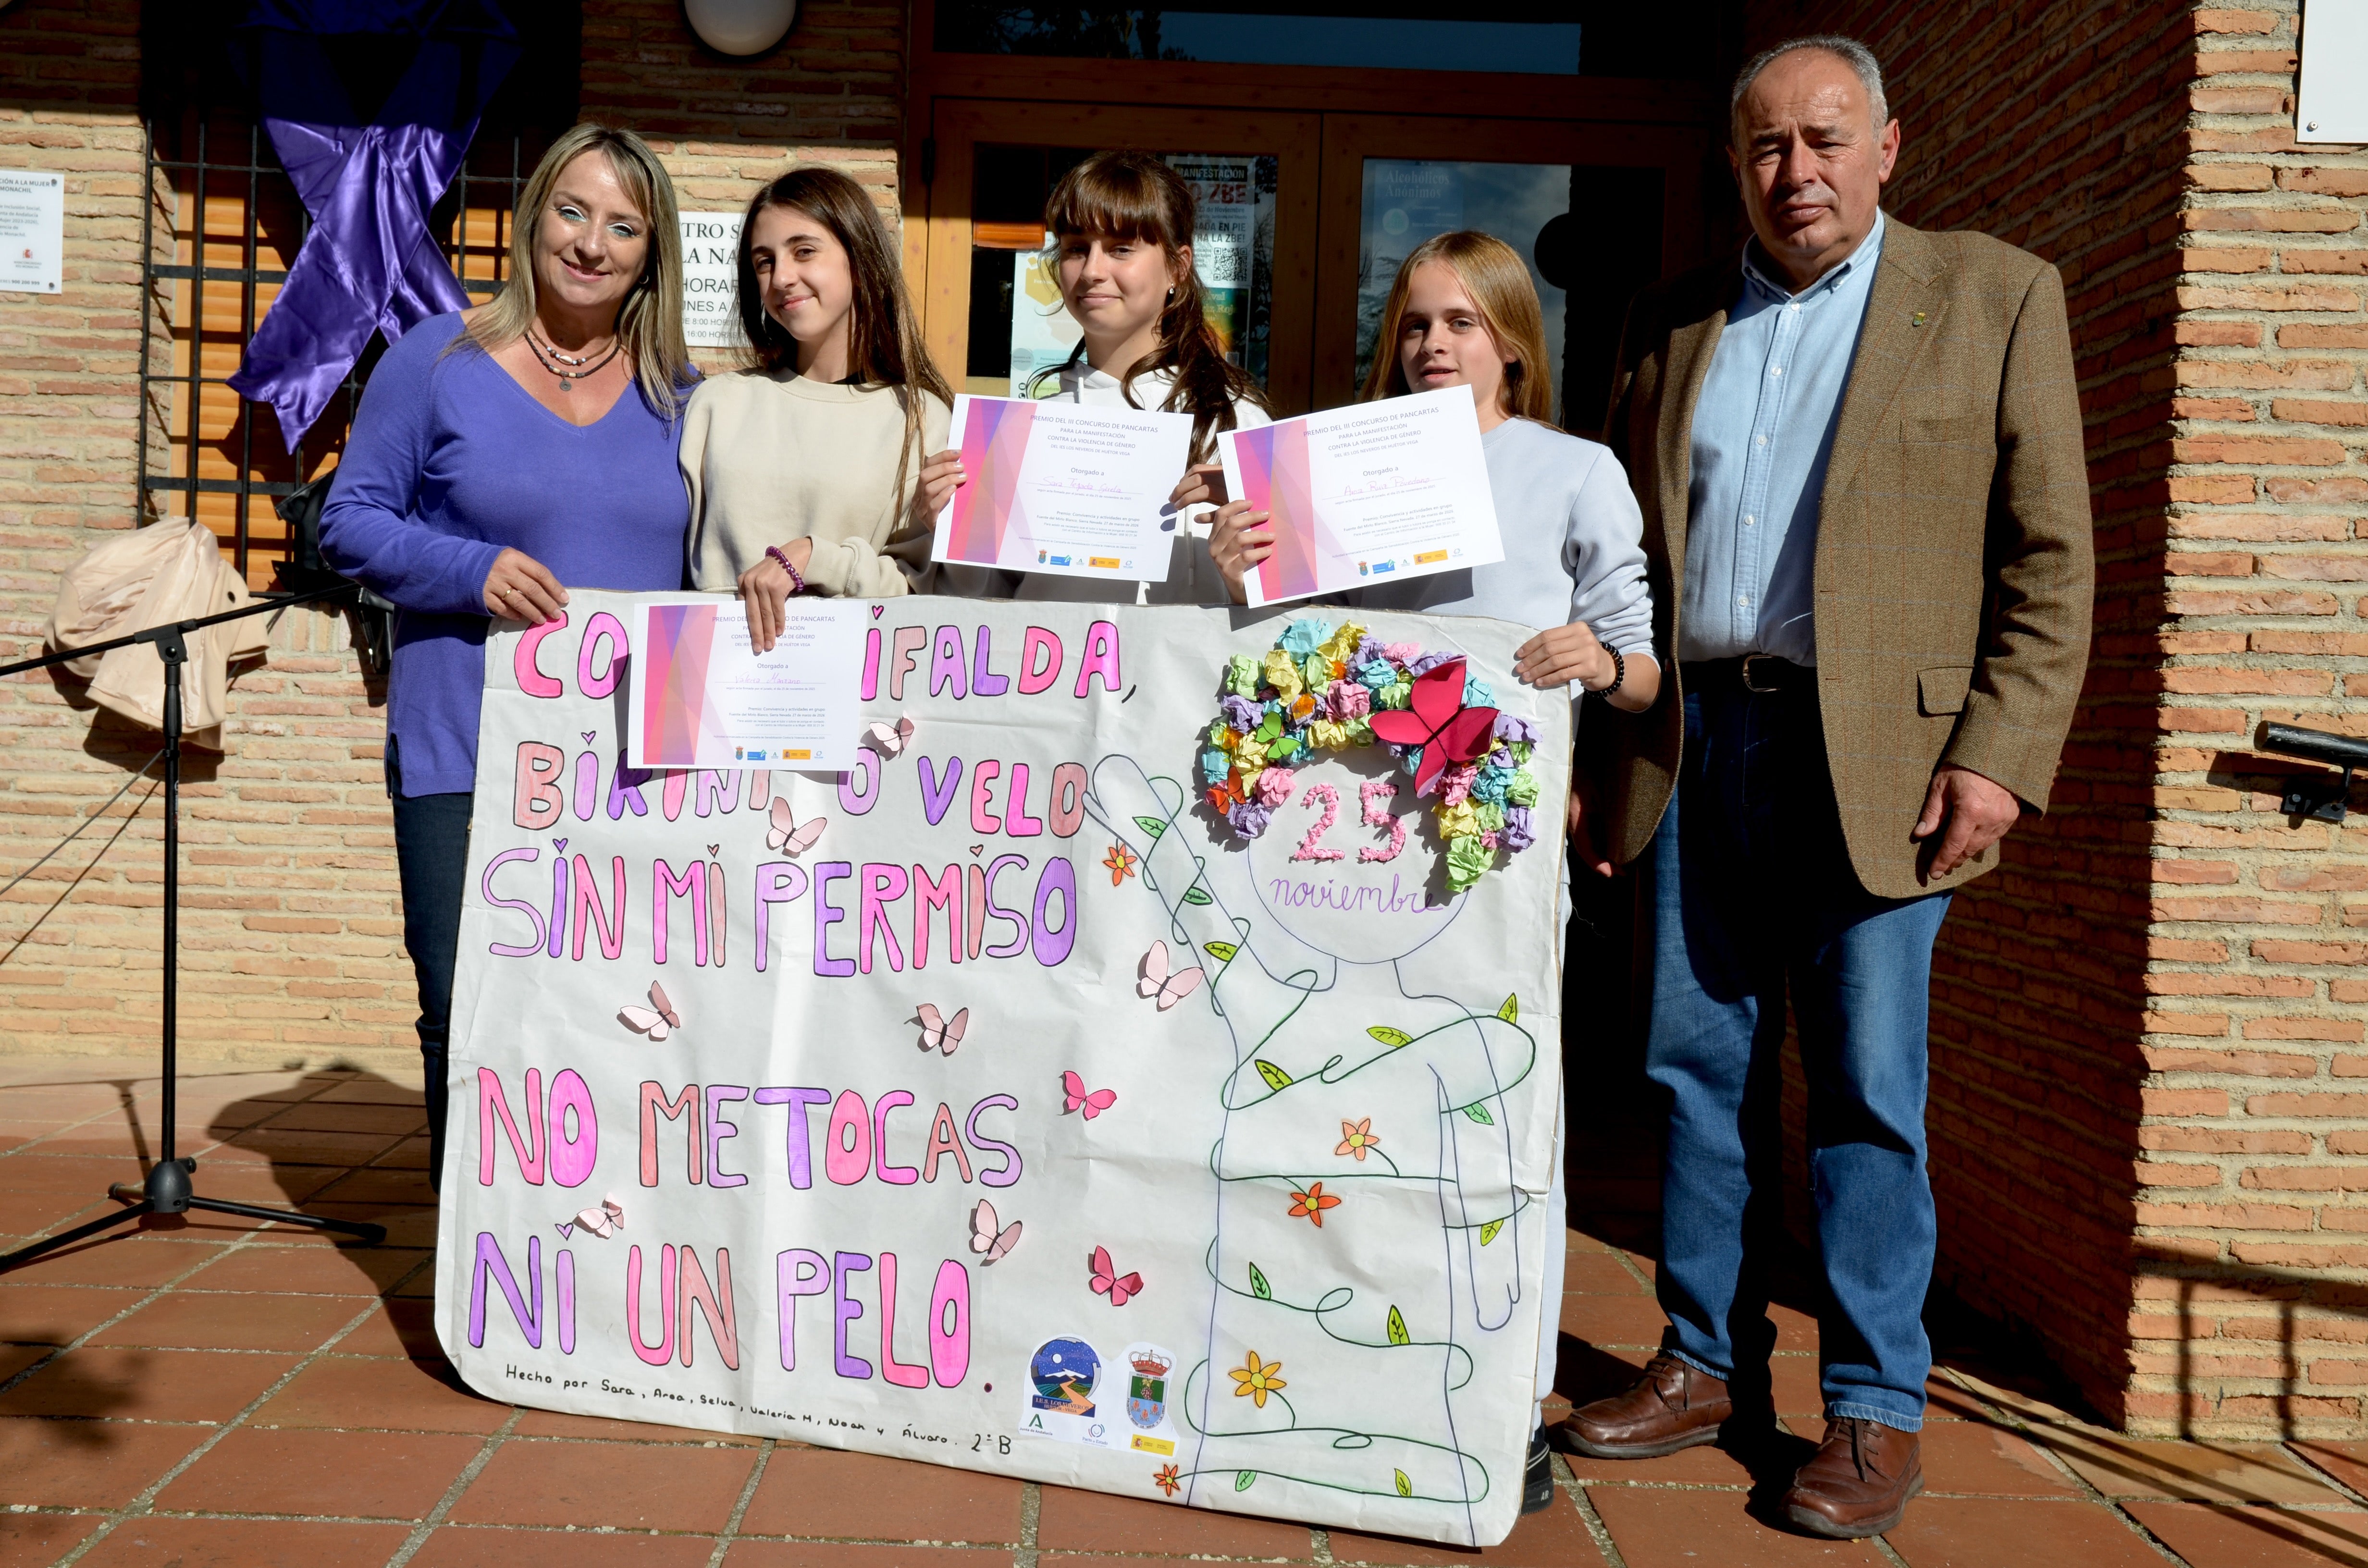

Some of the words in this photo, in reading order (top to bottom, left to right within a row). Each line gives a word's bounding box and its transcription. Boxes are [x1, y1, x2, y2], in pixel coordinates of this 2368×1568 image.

[1385, 170, 1450, 184] Alcohólicos
[1208, 184, 1246, 204] ZBE
[1385, 184, 1442, 198] Anónimos
[681, 222, 724, 239] TRO
[1219, 222, 1230, 232] EN
[1233, 222, 1246, 232] PIE
[1212, 234, 1222, 243] LA
[1225, 234, 1246, 243] ZBE!
[718, 302, 727, 312] A
[1075, 419, 1110, 428] CONCURSO
[1122, 424, 1158, 432] PANCARTAS
[1304, 427, 1328, 436] PREMIO
[1352, 416, 1388, 427] CONCURSO
[1400, 407, 1439, 419] PANCARTAS
[1083, 430, 1125, 439] MANIFESTACIÓN
[1363, 423, 1407, 435] MANIFESTACIÓN
[1328, 442, 1351, 451] CONTRA
[1360, 436, 1389, 444] VIOLENCIA
[1399, 430, 1421, 438] GÉNERO
[1363, 467, 1393, 476] Otorgado
[1043, 476, 1063, 487] Sara
[1068, 478, 1094, 490] Tejada
[514, 611, 629, 699] CO
[766, 673, 801, 684] Manzano
[917, 755, 1088, 838] VELO
[1294, 781, 1406, 863] 25
[1269, 873, 1443, 914] noviembre
[477, 1067, 598, 1188] NO
[627, 1243, 740, 1371] UN
[506, 1363, 553, 1384] Hecho
[564, 1379, 588, 1390] por
[828, 1418, 865, 1431] Noah
[1062, 1401, 1090, 1410] NEVEROS
[1541, 1490, 1549, 1501] AIR
